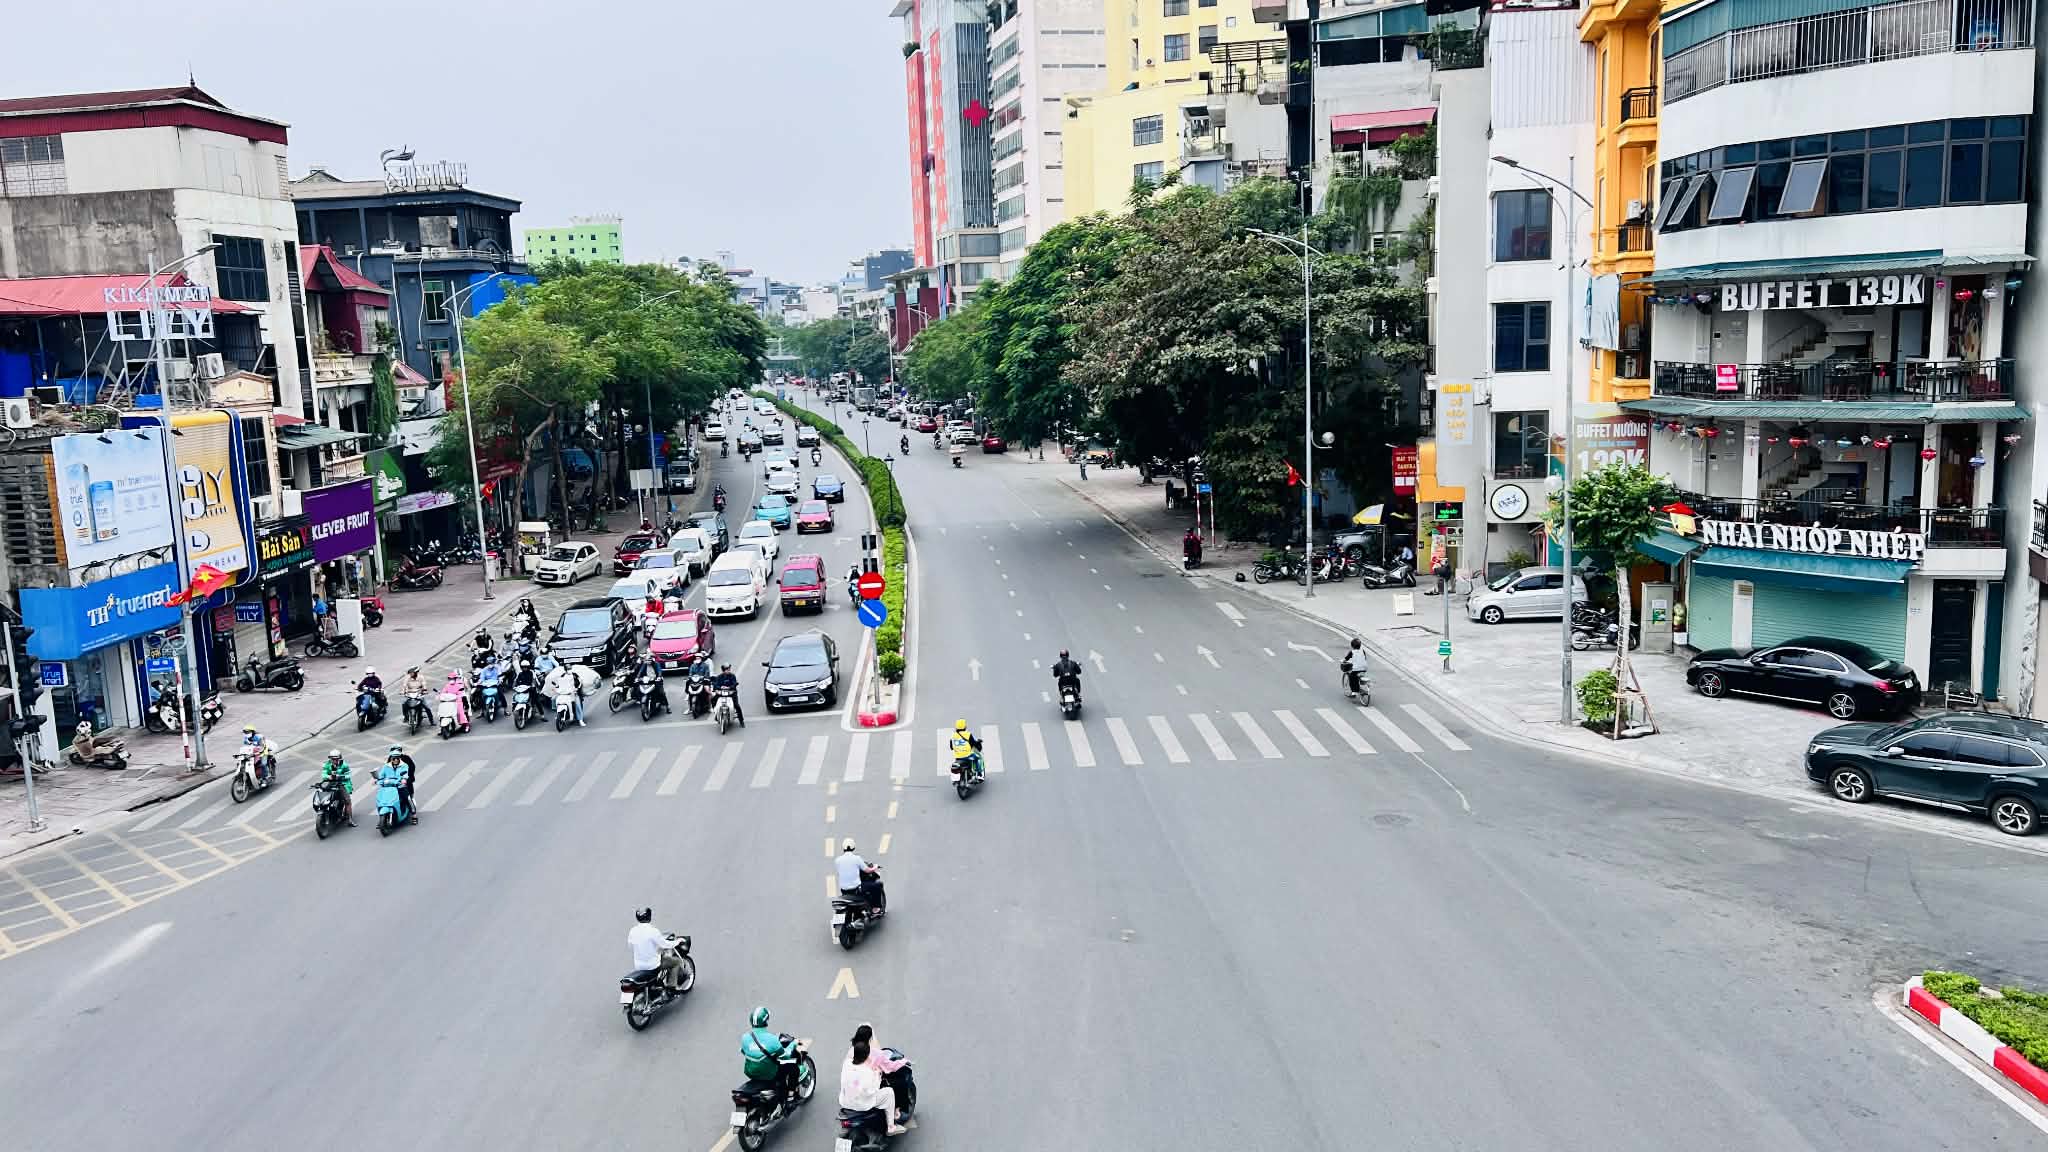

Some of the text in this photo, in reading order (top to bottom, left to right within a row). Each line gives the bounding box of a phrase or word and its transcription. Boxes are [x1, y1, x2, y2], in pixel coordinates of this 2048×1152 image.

[1722, 274, 1923, 311] BUFFET 139K
[107, 308, 211, 341] LILY
[1577, 424, 1611, 438] BUFFET
[312, 511, 369, 541] KLEVER FRUIT
[1772, 521, 1841, 553] NHÓP
[1850, 526, 1925, 560] NHÉP
[87, 606, 109, 627] TH
[237, 612, 259, 621] LILY
